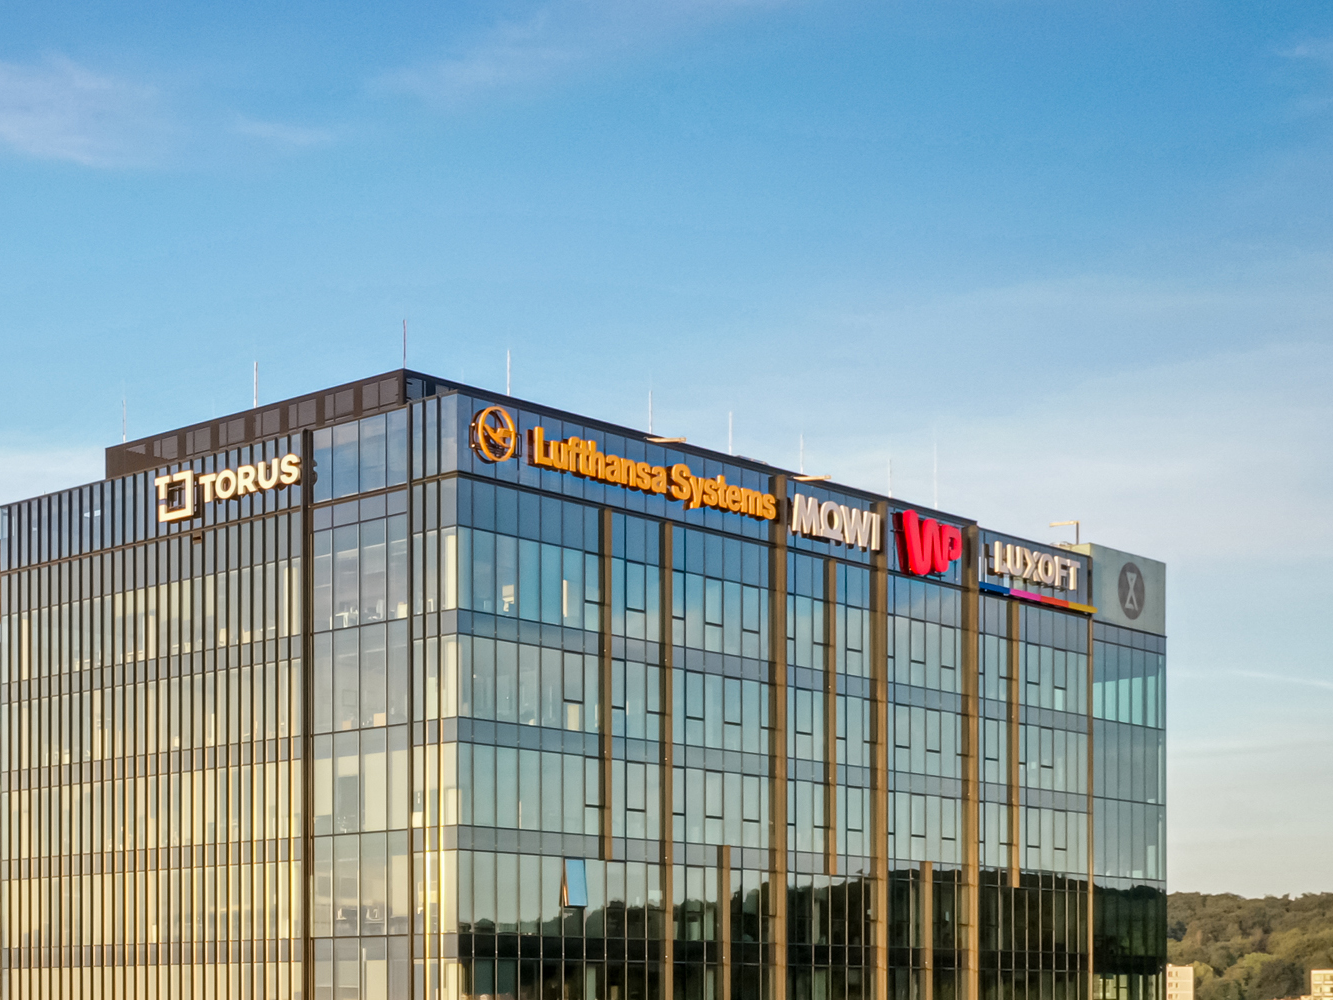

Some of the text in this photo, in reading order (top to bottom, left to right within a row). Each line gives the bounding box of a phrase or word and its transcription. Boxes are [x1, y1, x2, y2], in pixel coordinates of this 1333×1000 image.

[199, 453, 302, 503] TORUS
[533, 426, 777, 520] Lufthansa Systems
[791, 492, 881, 552] MOWI
[902, 508, 963, 577] WP
[993, 539, 1082, 592] LUXOFT
